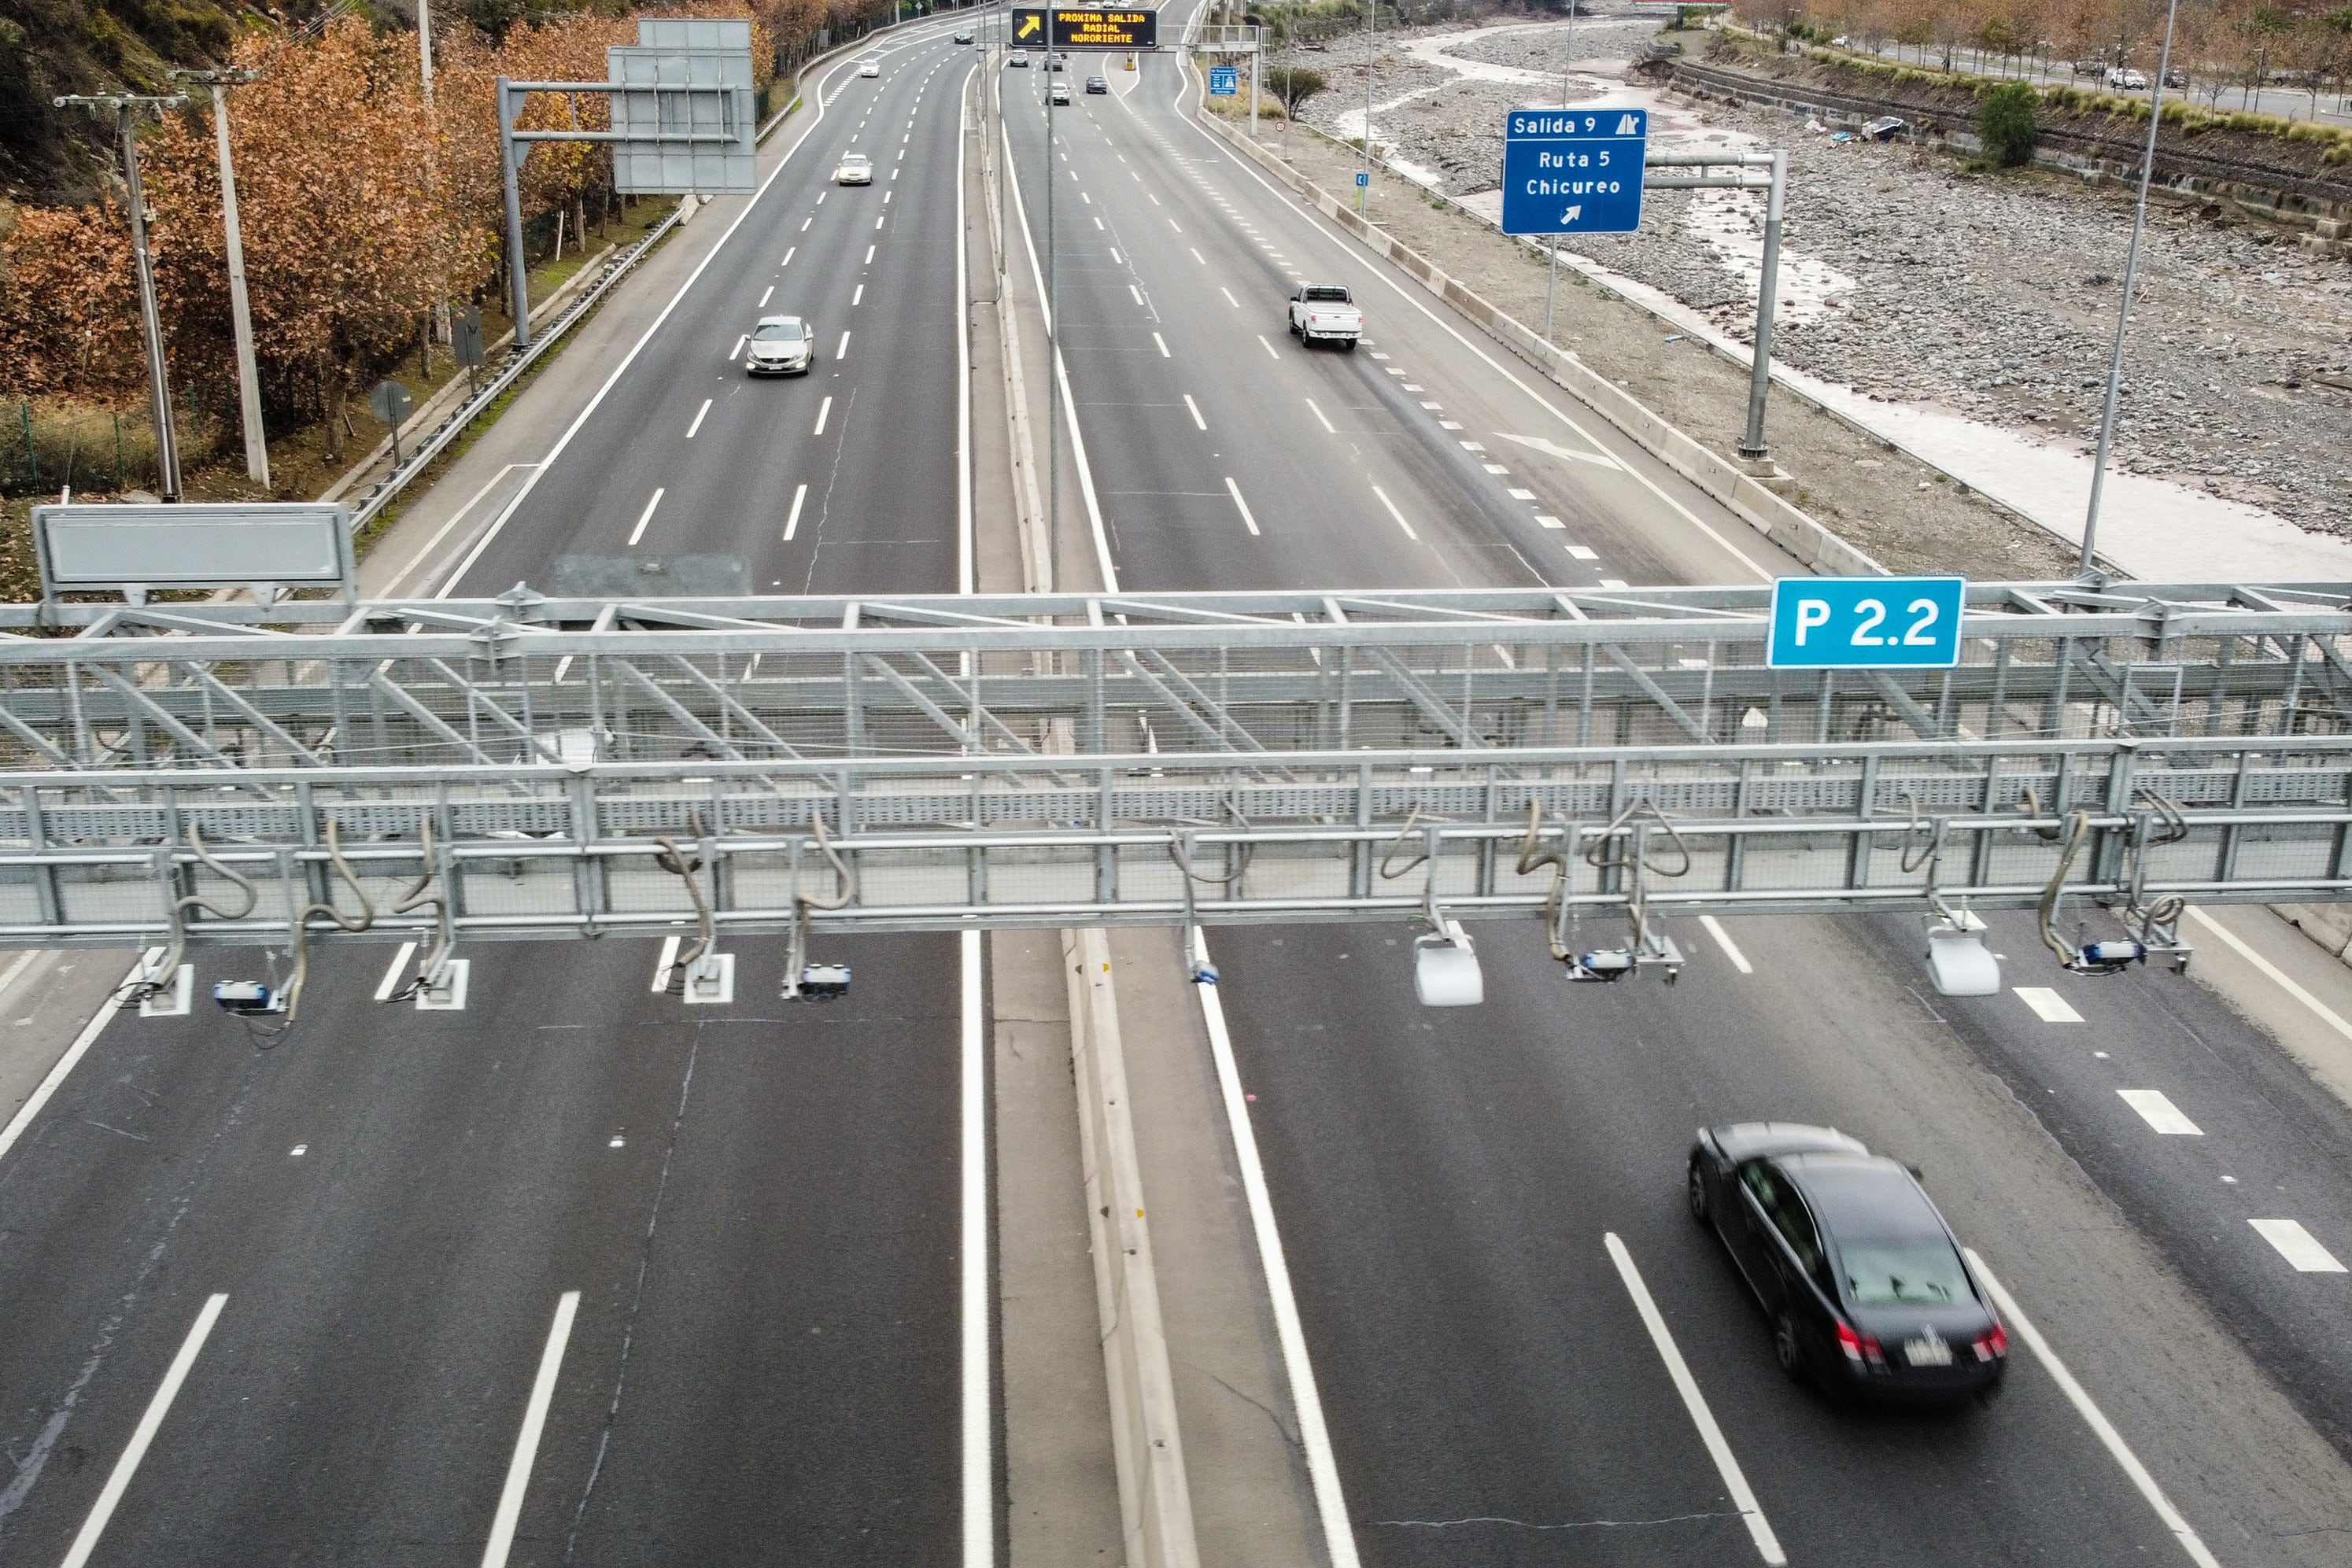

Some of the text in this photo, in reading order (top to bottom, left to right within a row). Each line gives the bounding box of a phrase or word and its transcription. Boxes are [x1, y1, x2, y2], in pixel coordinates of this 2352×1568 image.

[1058, 13, 1146, 23] PROXIMA SALIDA
[1083, 24, 1121, 33] RADIAL
[1514, 117, 1596, 134] Salida 9
[1539, 150, 1610, 168] Ruta 5
[1527, 179, 1620, 195] Chicureo
[1795, 598, 1940, 647] P 2.2
